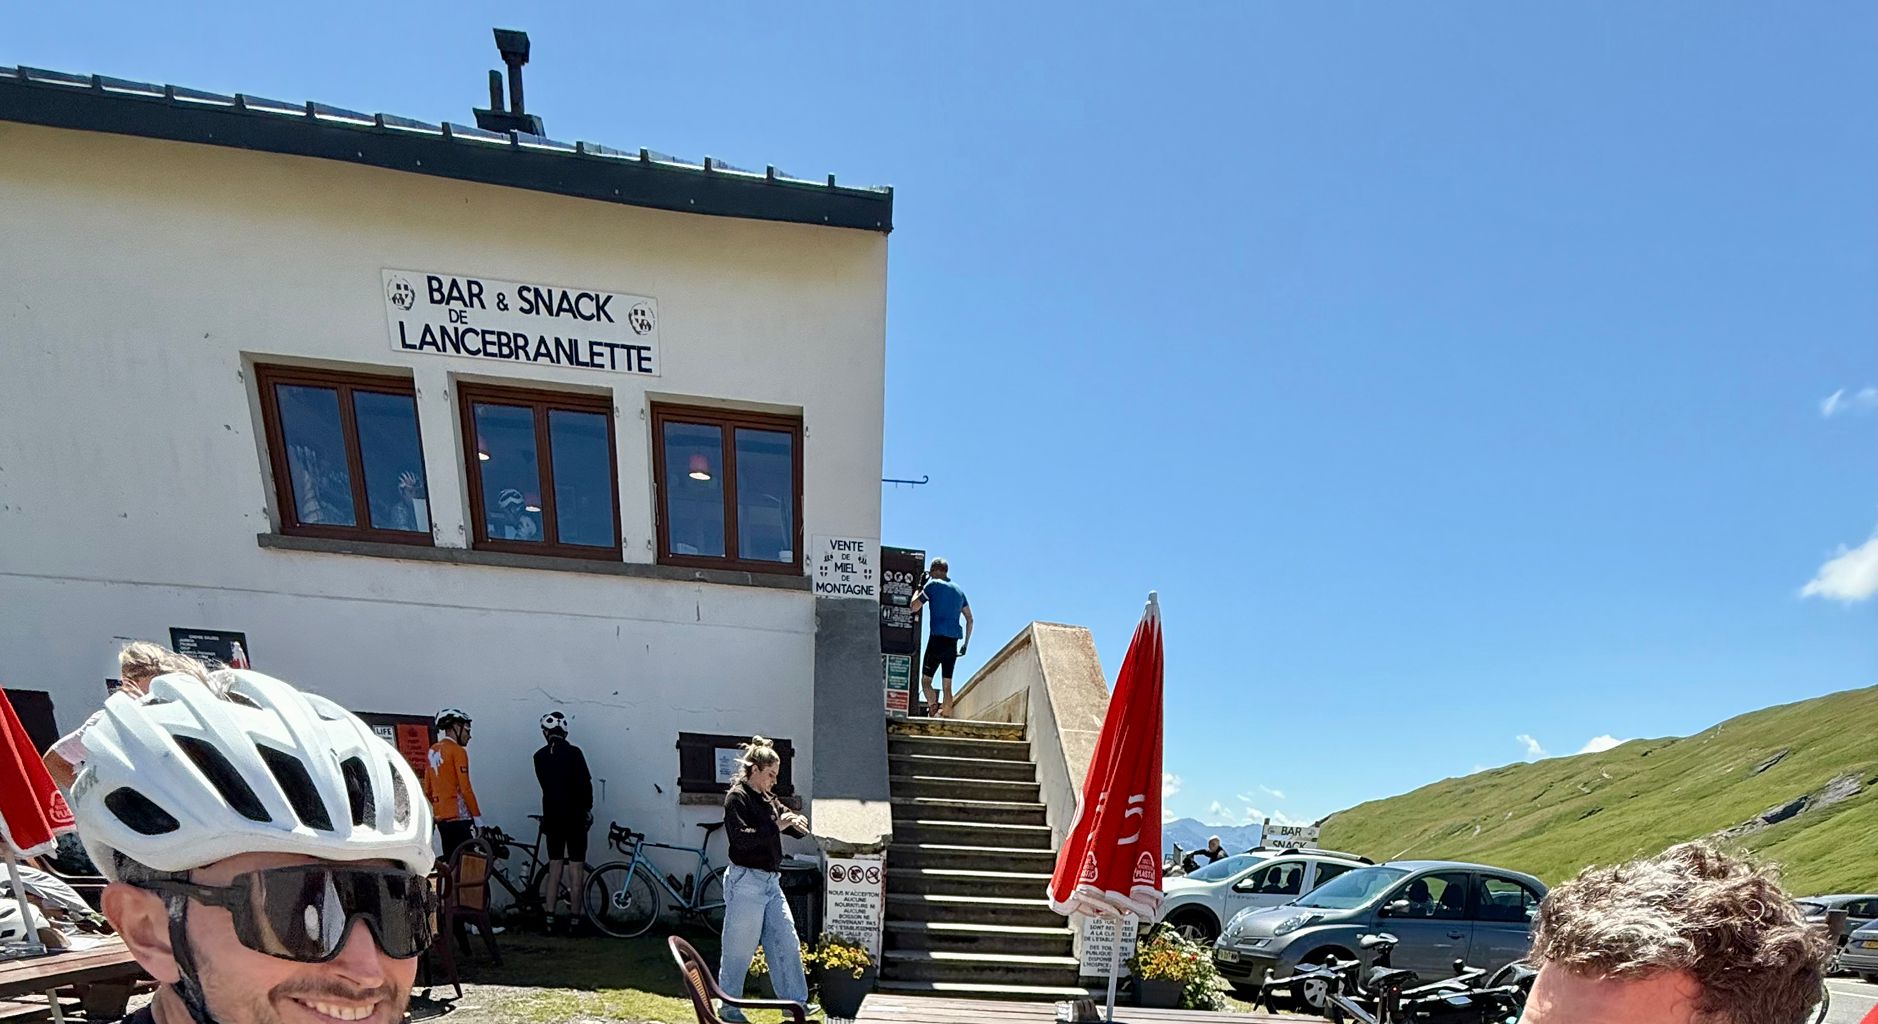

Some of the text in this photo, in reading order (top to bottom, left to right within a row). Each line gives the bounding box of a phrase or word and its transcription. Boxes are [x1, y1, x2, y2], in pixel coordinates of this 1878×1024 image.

[428, 276, 614, 323] BAR & SNACK
[449, 309, 468, 324] DE
[399, 321, 652, 373] LANCEBRANLETTE
[830, 539, 863, 552] VENTE
[835, 562, 857, 573] MIEL
[816, 582, 874, 595] MONTAGNE
[1281, 826, 1302, 836] BAR
[1272, 840, 1307, 848] SNACK
